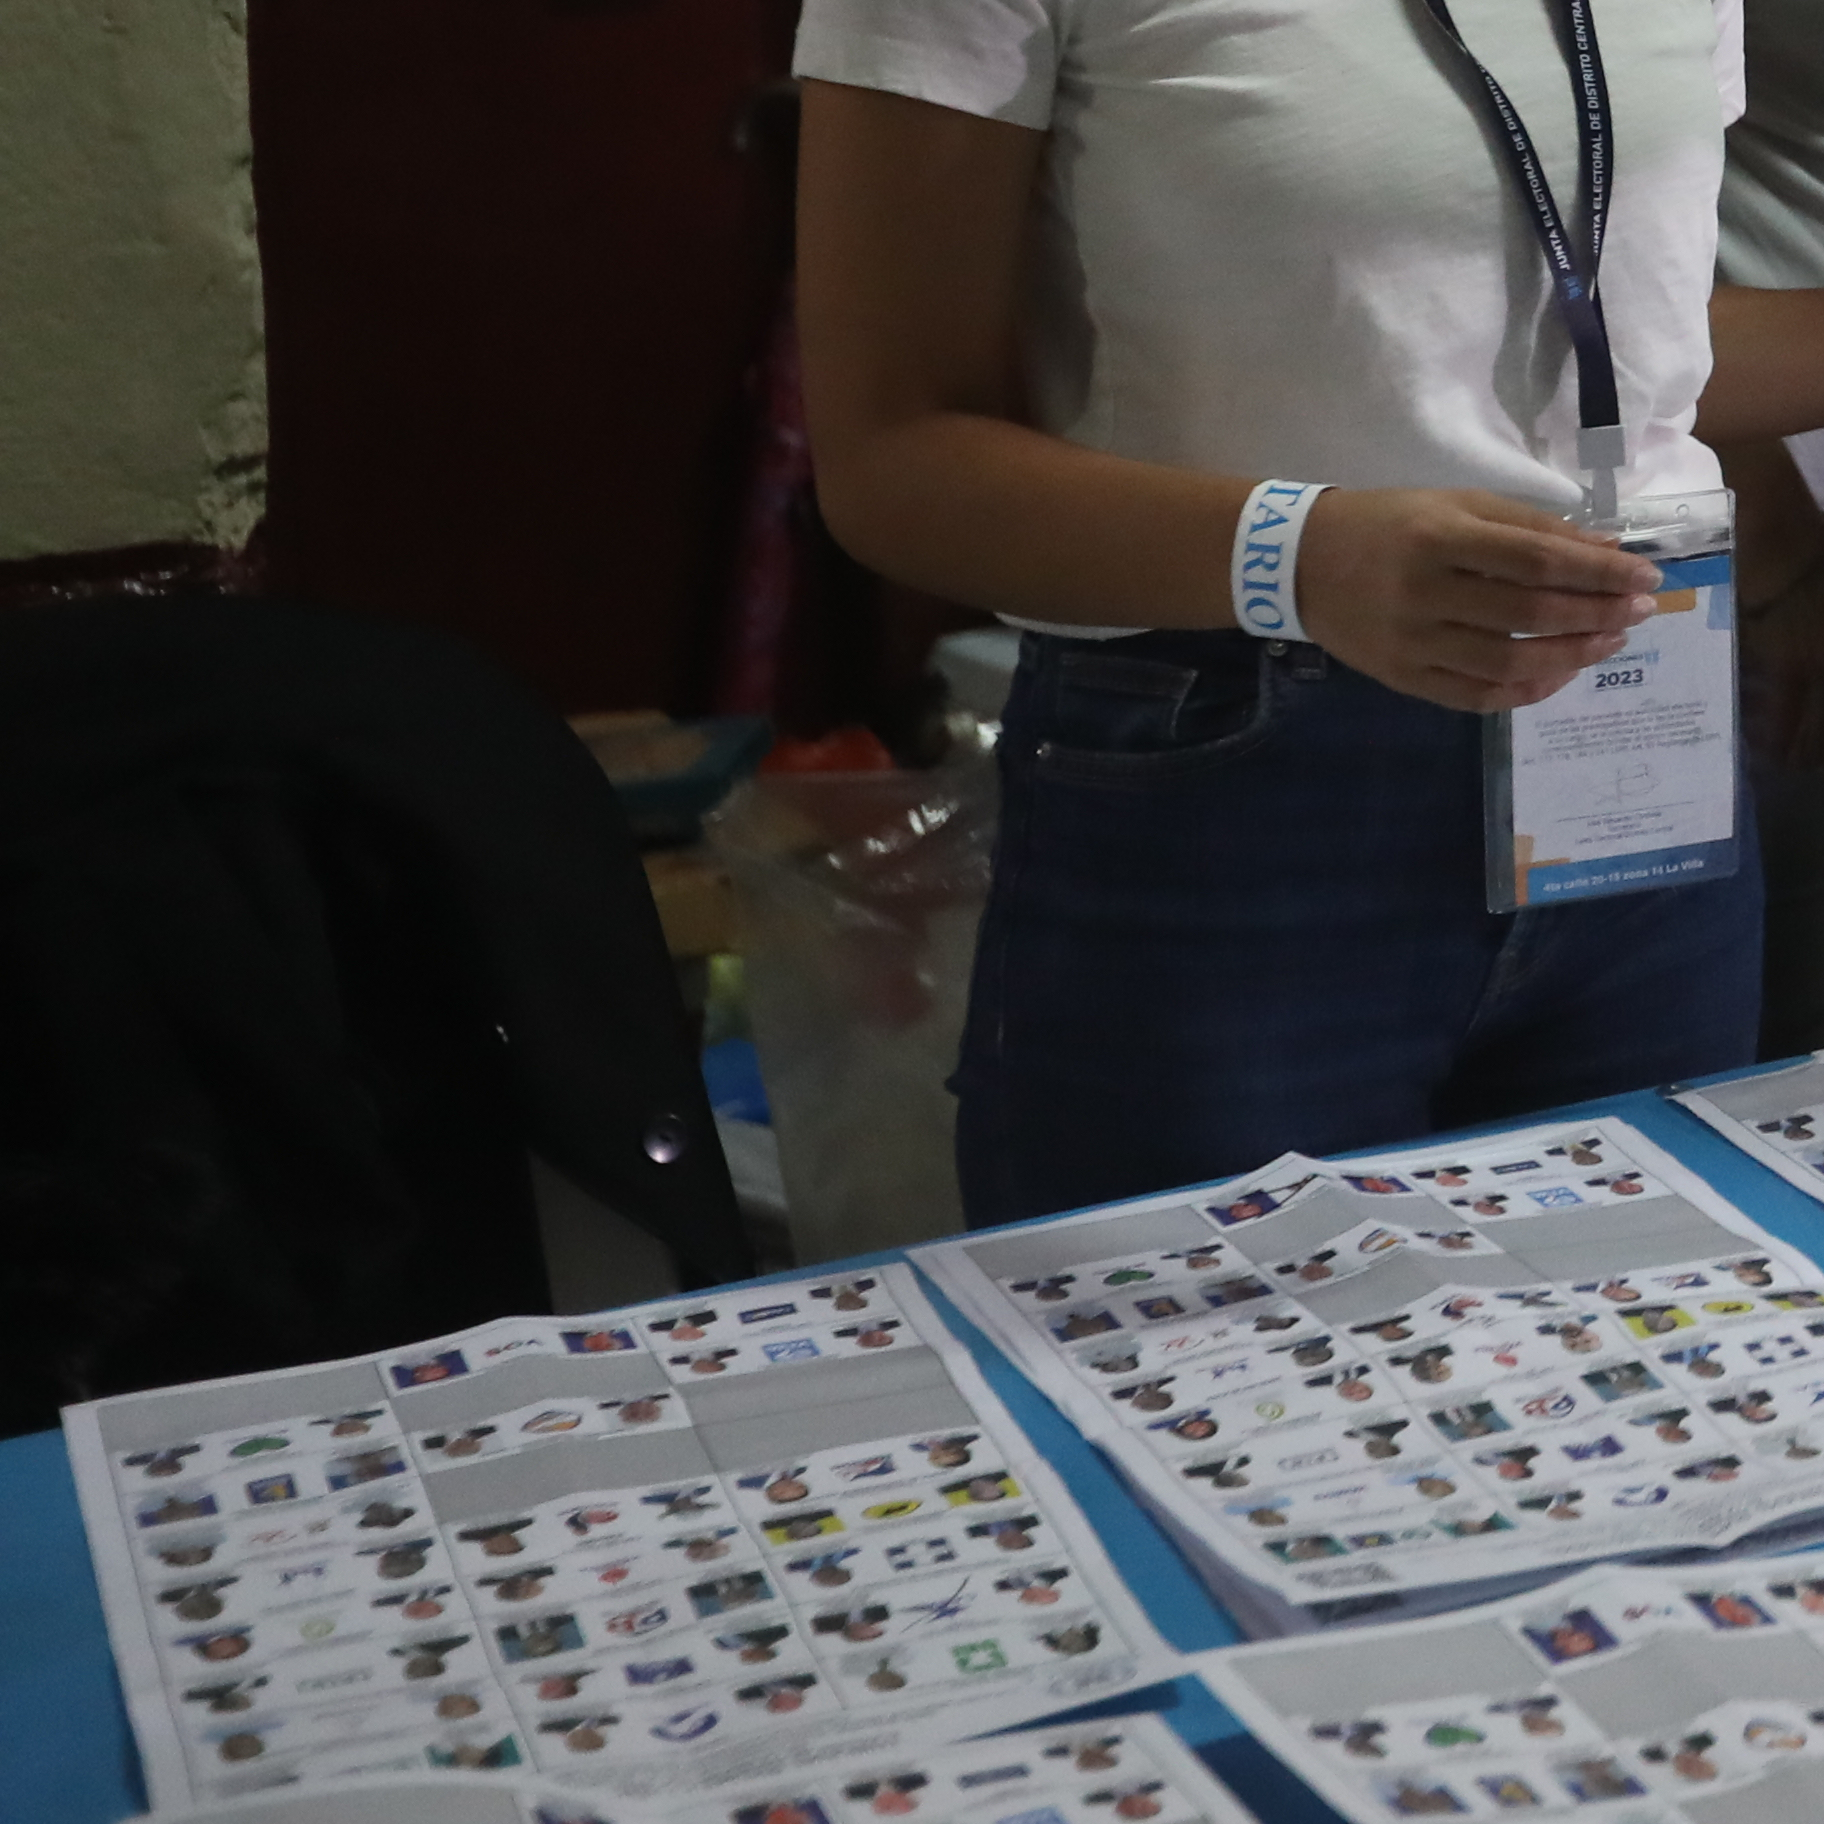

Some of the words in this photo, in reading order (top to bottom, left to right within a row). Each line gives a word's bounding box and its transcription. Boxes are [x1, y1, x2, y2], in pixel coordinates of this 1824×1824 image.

[1579, 54, 1600, 109] DISTRITO
[1512, 133, 1526, 152] DE
[1588, 113, 1602, 130] DE
[1521, 152, 1554, 228] ELECTORAL
[1591, 133, 1604, 210] ELECTORAL
[1549, 229, 1571, 271] JUNTA
[1595, 669, 1644, 688] 2023
